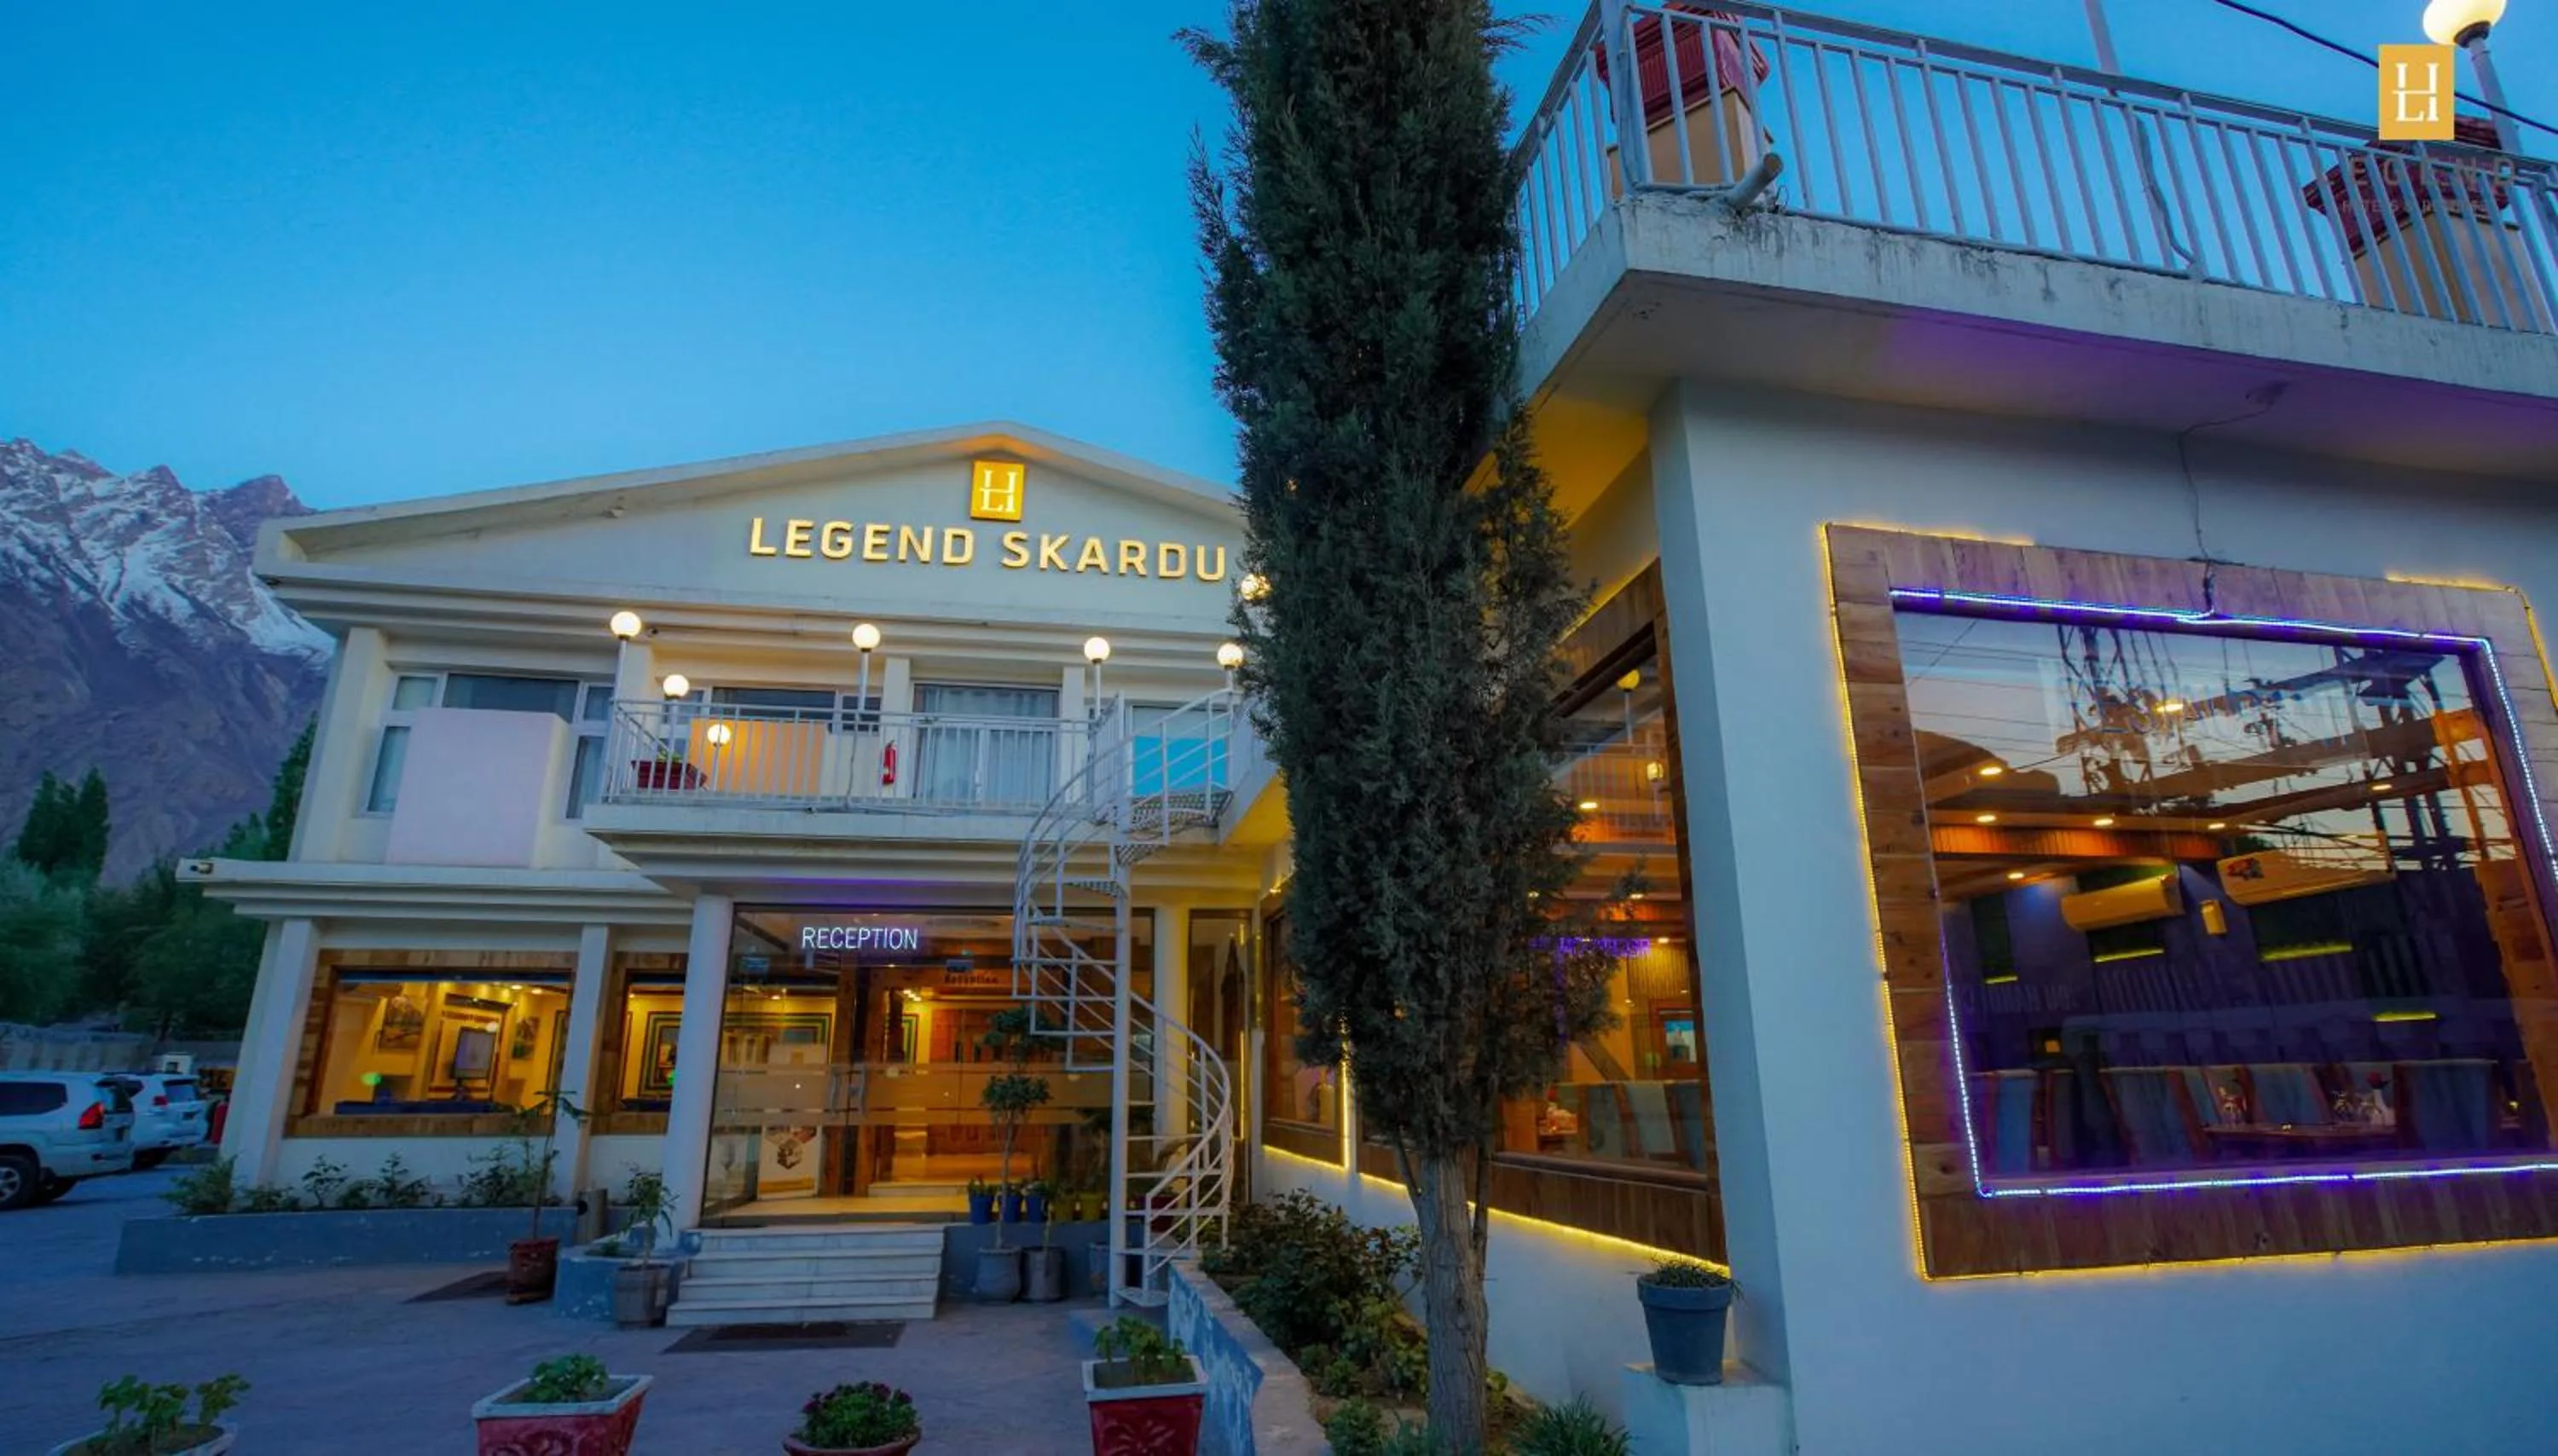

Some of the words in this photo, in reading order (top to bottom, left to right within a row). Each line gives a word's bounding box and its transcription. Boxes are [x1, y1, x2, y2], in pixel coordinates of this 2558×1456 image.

[749, 517, 975, 566] LEGEND
[1001, 534, 1226, 581] SKARDU
[802, 927, 918, 950] RECEPTION
